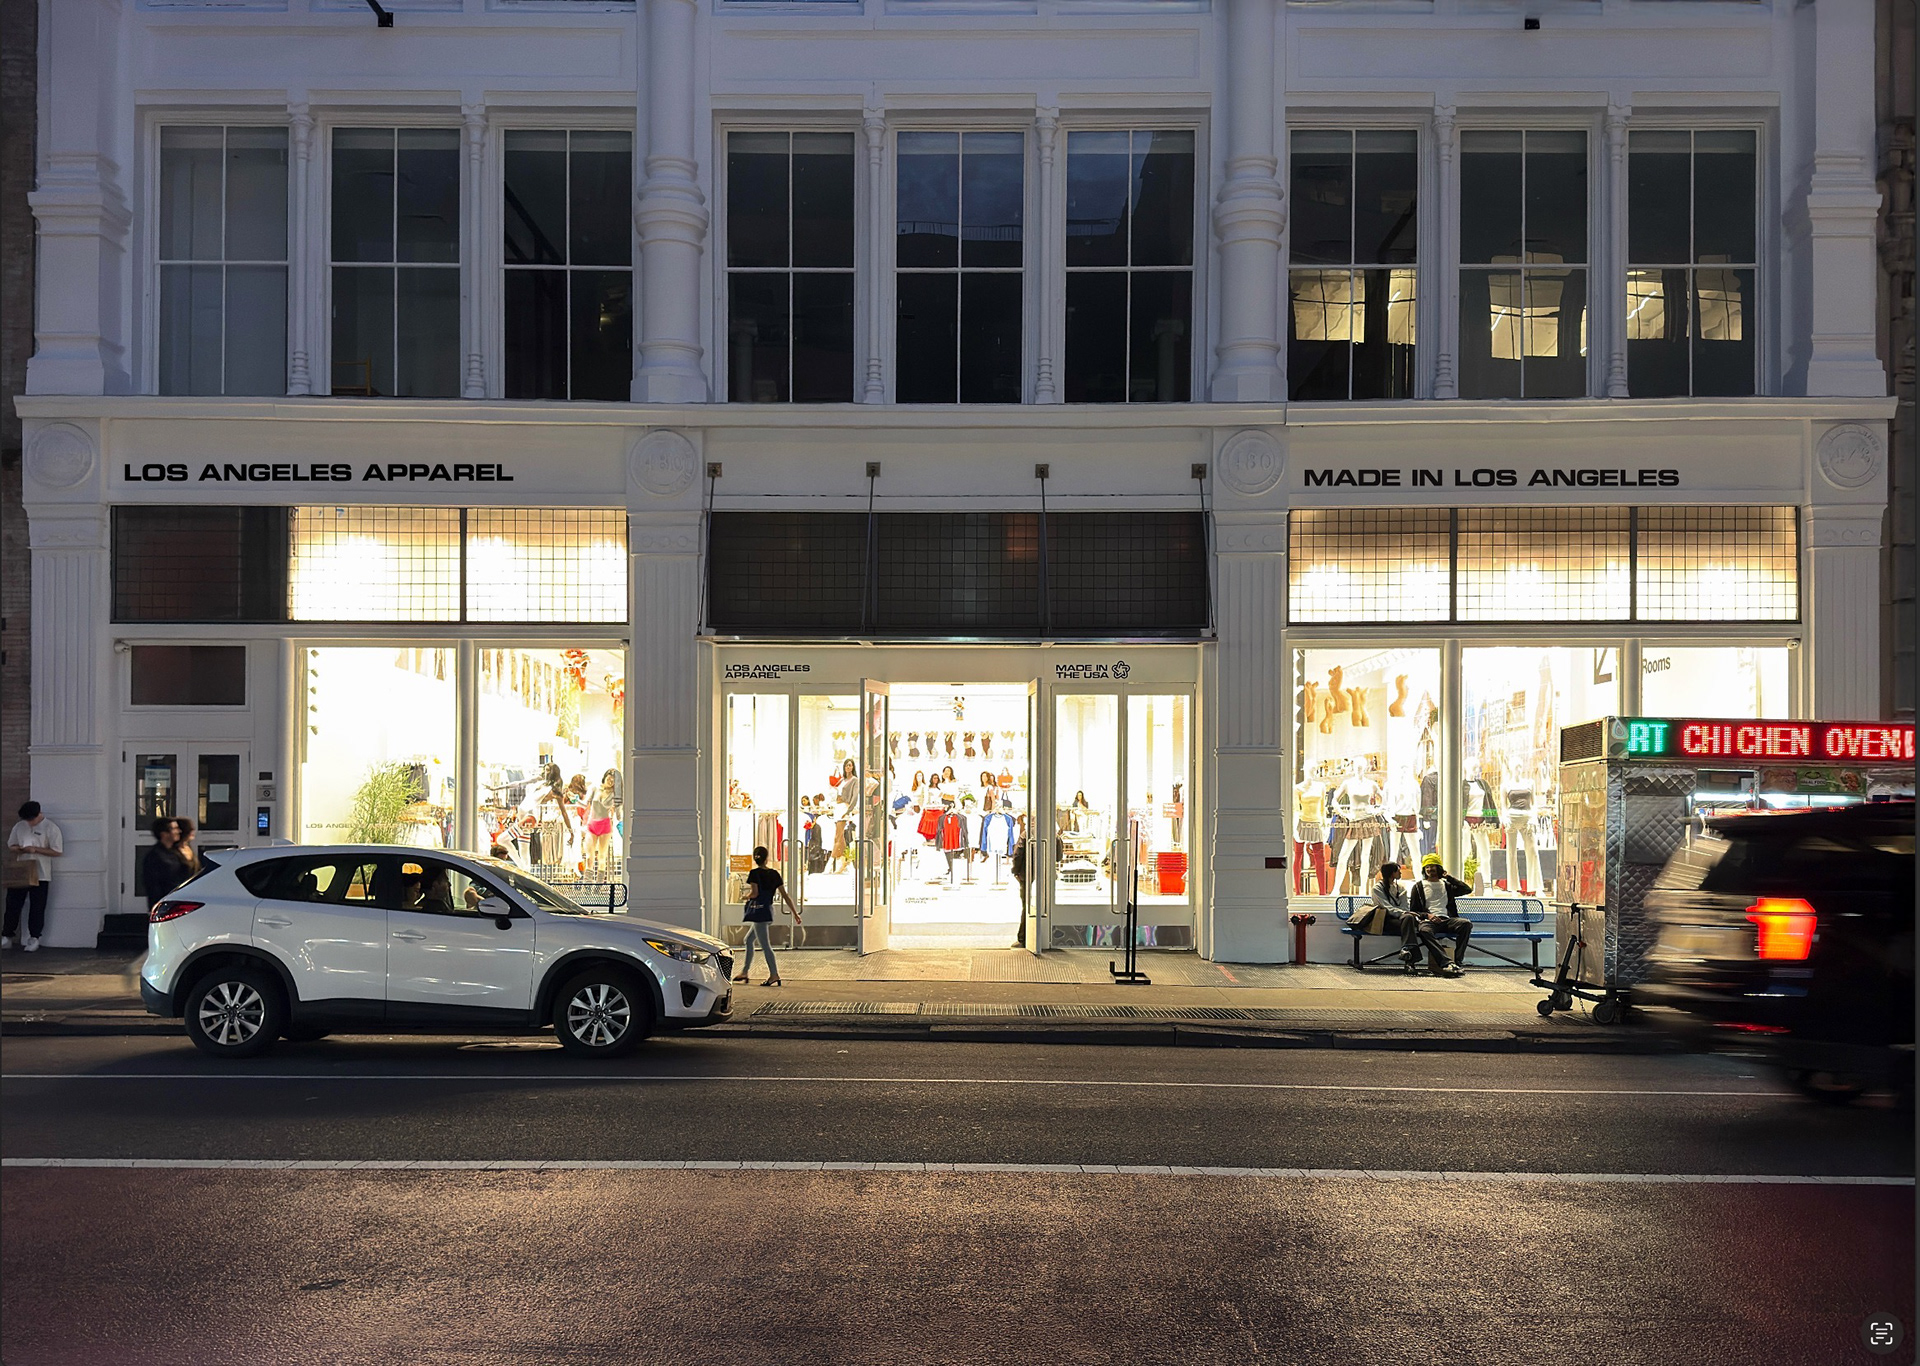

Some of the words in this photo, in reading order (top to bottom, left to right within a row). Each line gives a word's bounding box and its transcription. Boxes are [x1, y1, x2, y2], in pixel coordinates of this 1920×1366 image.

[124, 463, 189, 482] LOS
[198, 463, 353, 482] ANGELES
[361, 463, 514, 482] APPAREL
[1304, 469, 1401, 487] MADE
[1411, 469, 1443, 487] IN
[1454, 468, 1518, 487] LOS
[1527, 469, 1680, 487] ANGELES
[725, 664, 750, 672] LOS
[753, 664, 811, 672] ANGELES
[1055, 664, 1093, 672] MADE
[1095, 664, 1108, 672] IN
[1641, 656, 1671, 674] Rooms
[724, 671, 781, 679] APPAREL
[1055, 671, 1080, 679] THE
[1083, 671, 1109, 679] USA
